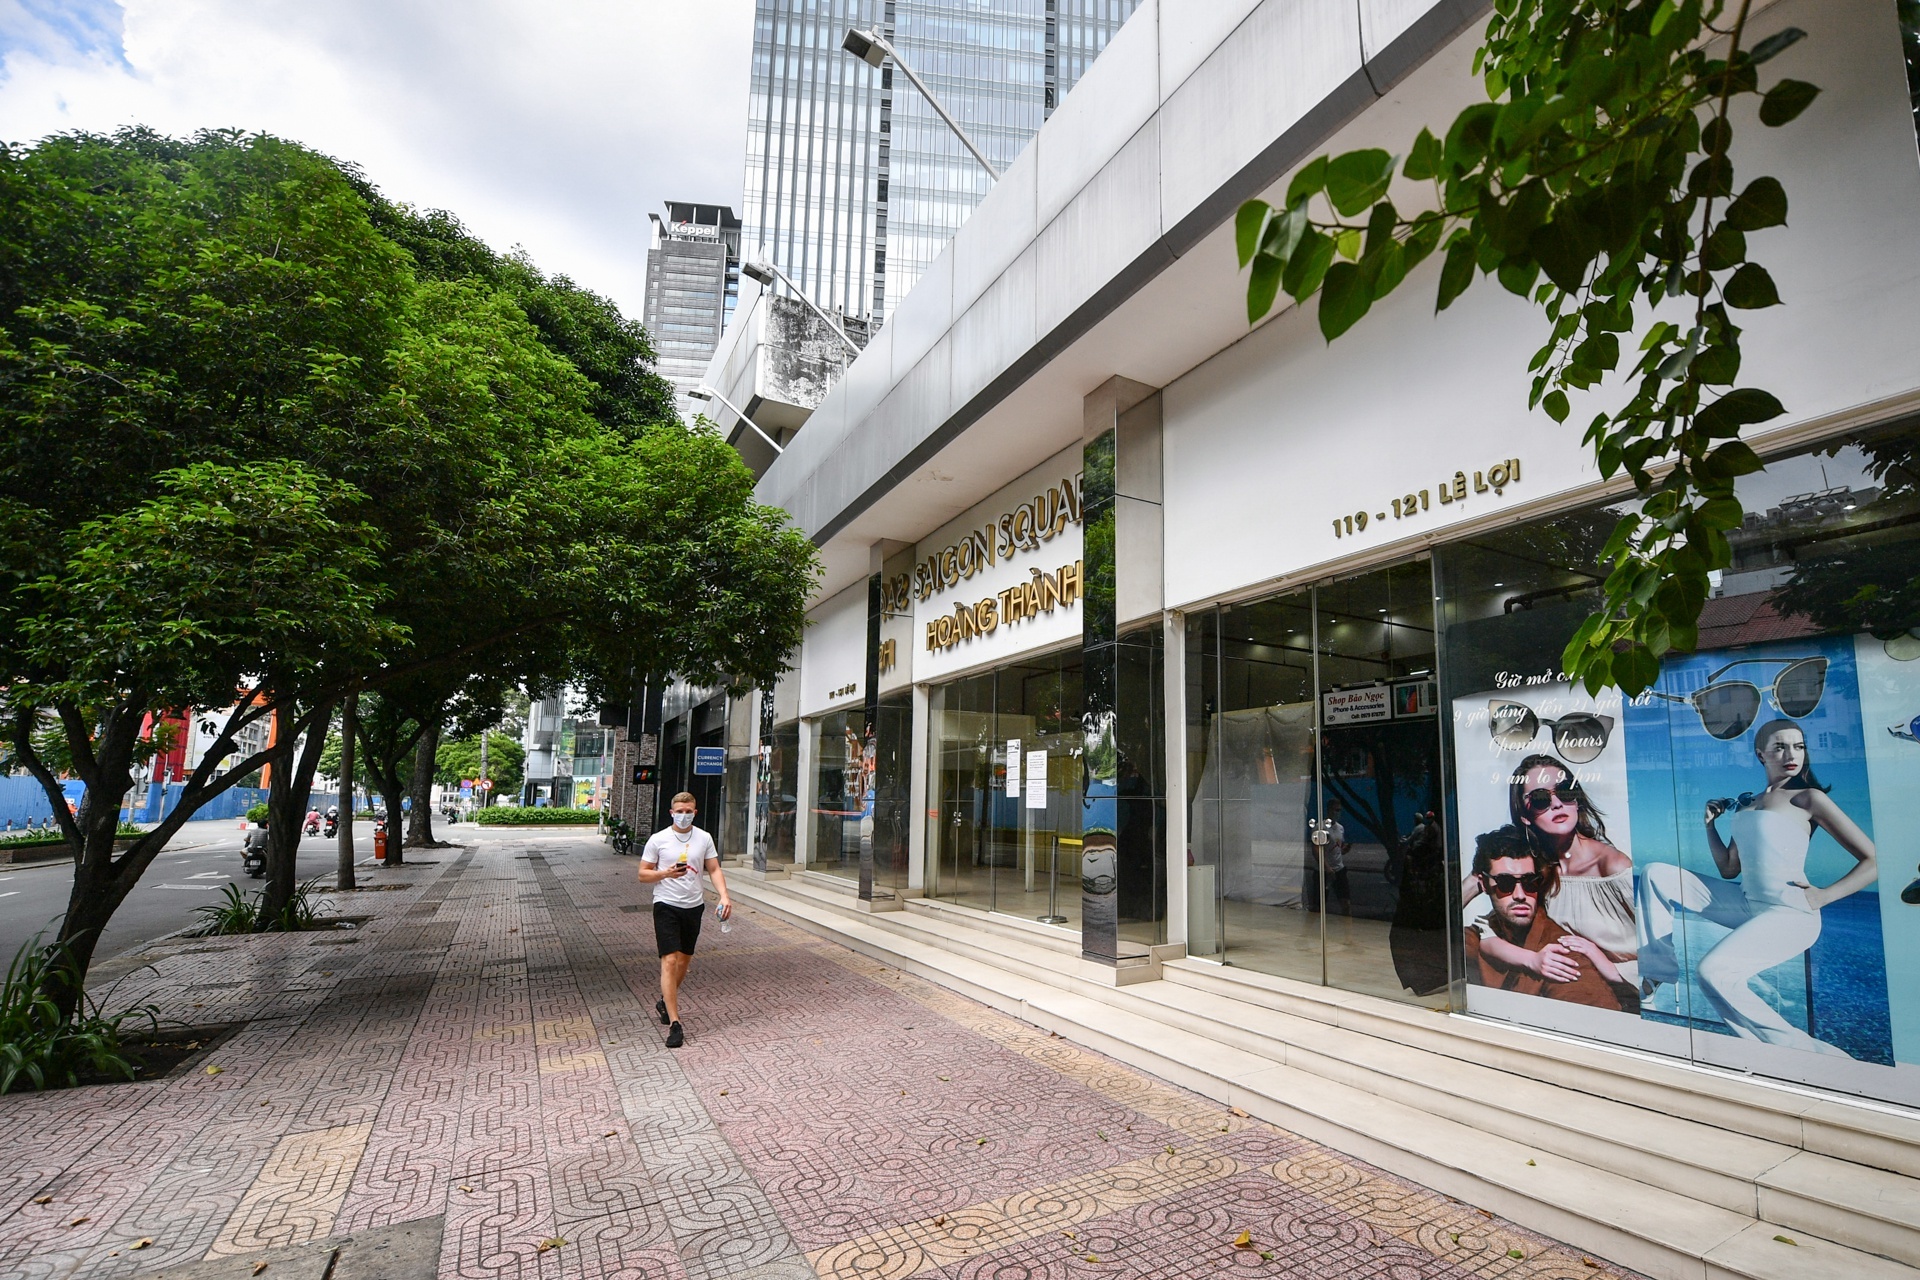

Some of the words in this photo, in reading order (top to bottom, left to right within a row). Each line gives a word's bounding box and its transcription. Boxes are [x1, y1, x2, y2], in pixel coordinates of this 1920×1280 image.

[671, 223, 715, 236] Keppel
[1332, 511, 1368, 538] 119
[1391, 489, 1429, 519] 121
[1438, 470, 1467, 504] LÊ
[1473, 458, 1520, 496] LỢI
[914, 524, 996, 601] SAIGON
[926, 598, 998, 652] HOÀNG
[998, 559, 1083, 625] THÀNH
[1494, 670, 1522, 689] Giờ
[1526, 668, 1552, 687] mở
[1328, 696, 1346, 706] Shop
[1364, 692, 1384, 703] Ngọc
[1355, 702, 1384, 711] Accessories
[1453, 711, 1463, 723] 9
[1465, 708, 1489, 729] giờ
[1493, 704, 1528, 724] sáng
[1489, 734, 1552, 758] Opening
[1558, 731, 1604, 749] hours
[1490, 771, 1500, 785] 9
[1506, 773, 1531, 785] am
[1537, 767, 1550, 784] to
[1556, 769, 1567, 783] 9
[1570, 767, 1601, 790] pm
